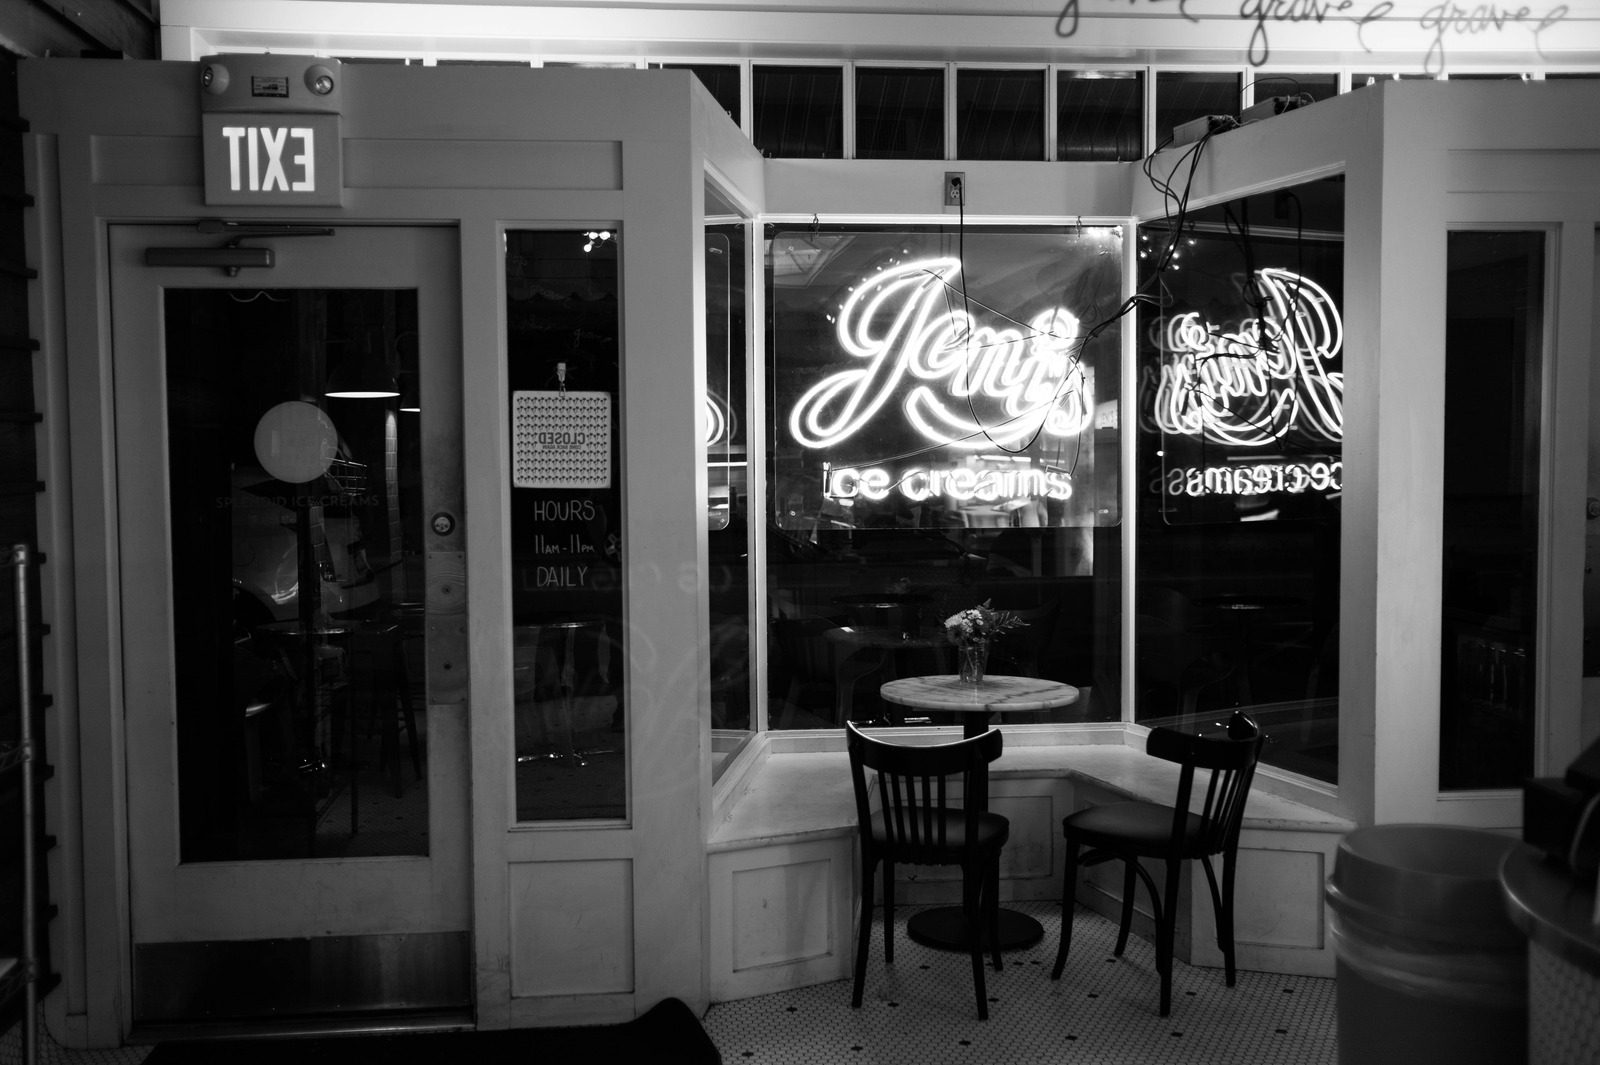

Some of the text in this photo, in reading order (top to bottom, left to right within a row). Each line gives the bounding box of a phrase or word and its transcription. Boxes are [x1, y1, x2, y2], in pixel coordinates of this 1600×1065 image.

[823, 462, 1073, 501] ice creams
[216, 494, 380, 509] SPLENDID ICE CREAMS
[534, 500, 595, 522] HOURS
[537, 565, 588, 587] DAILY
